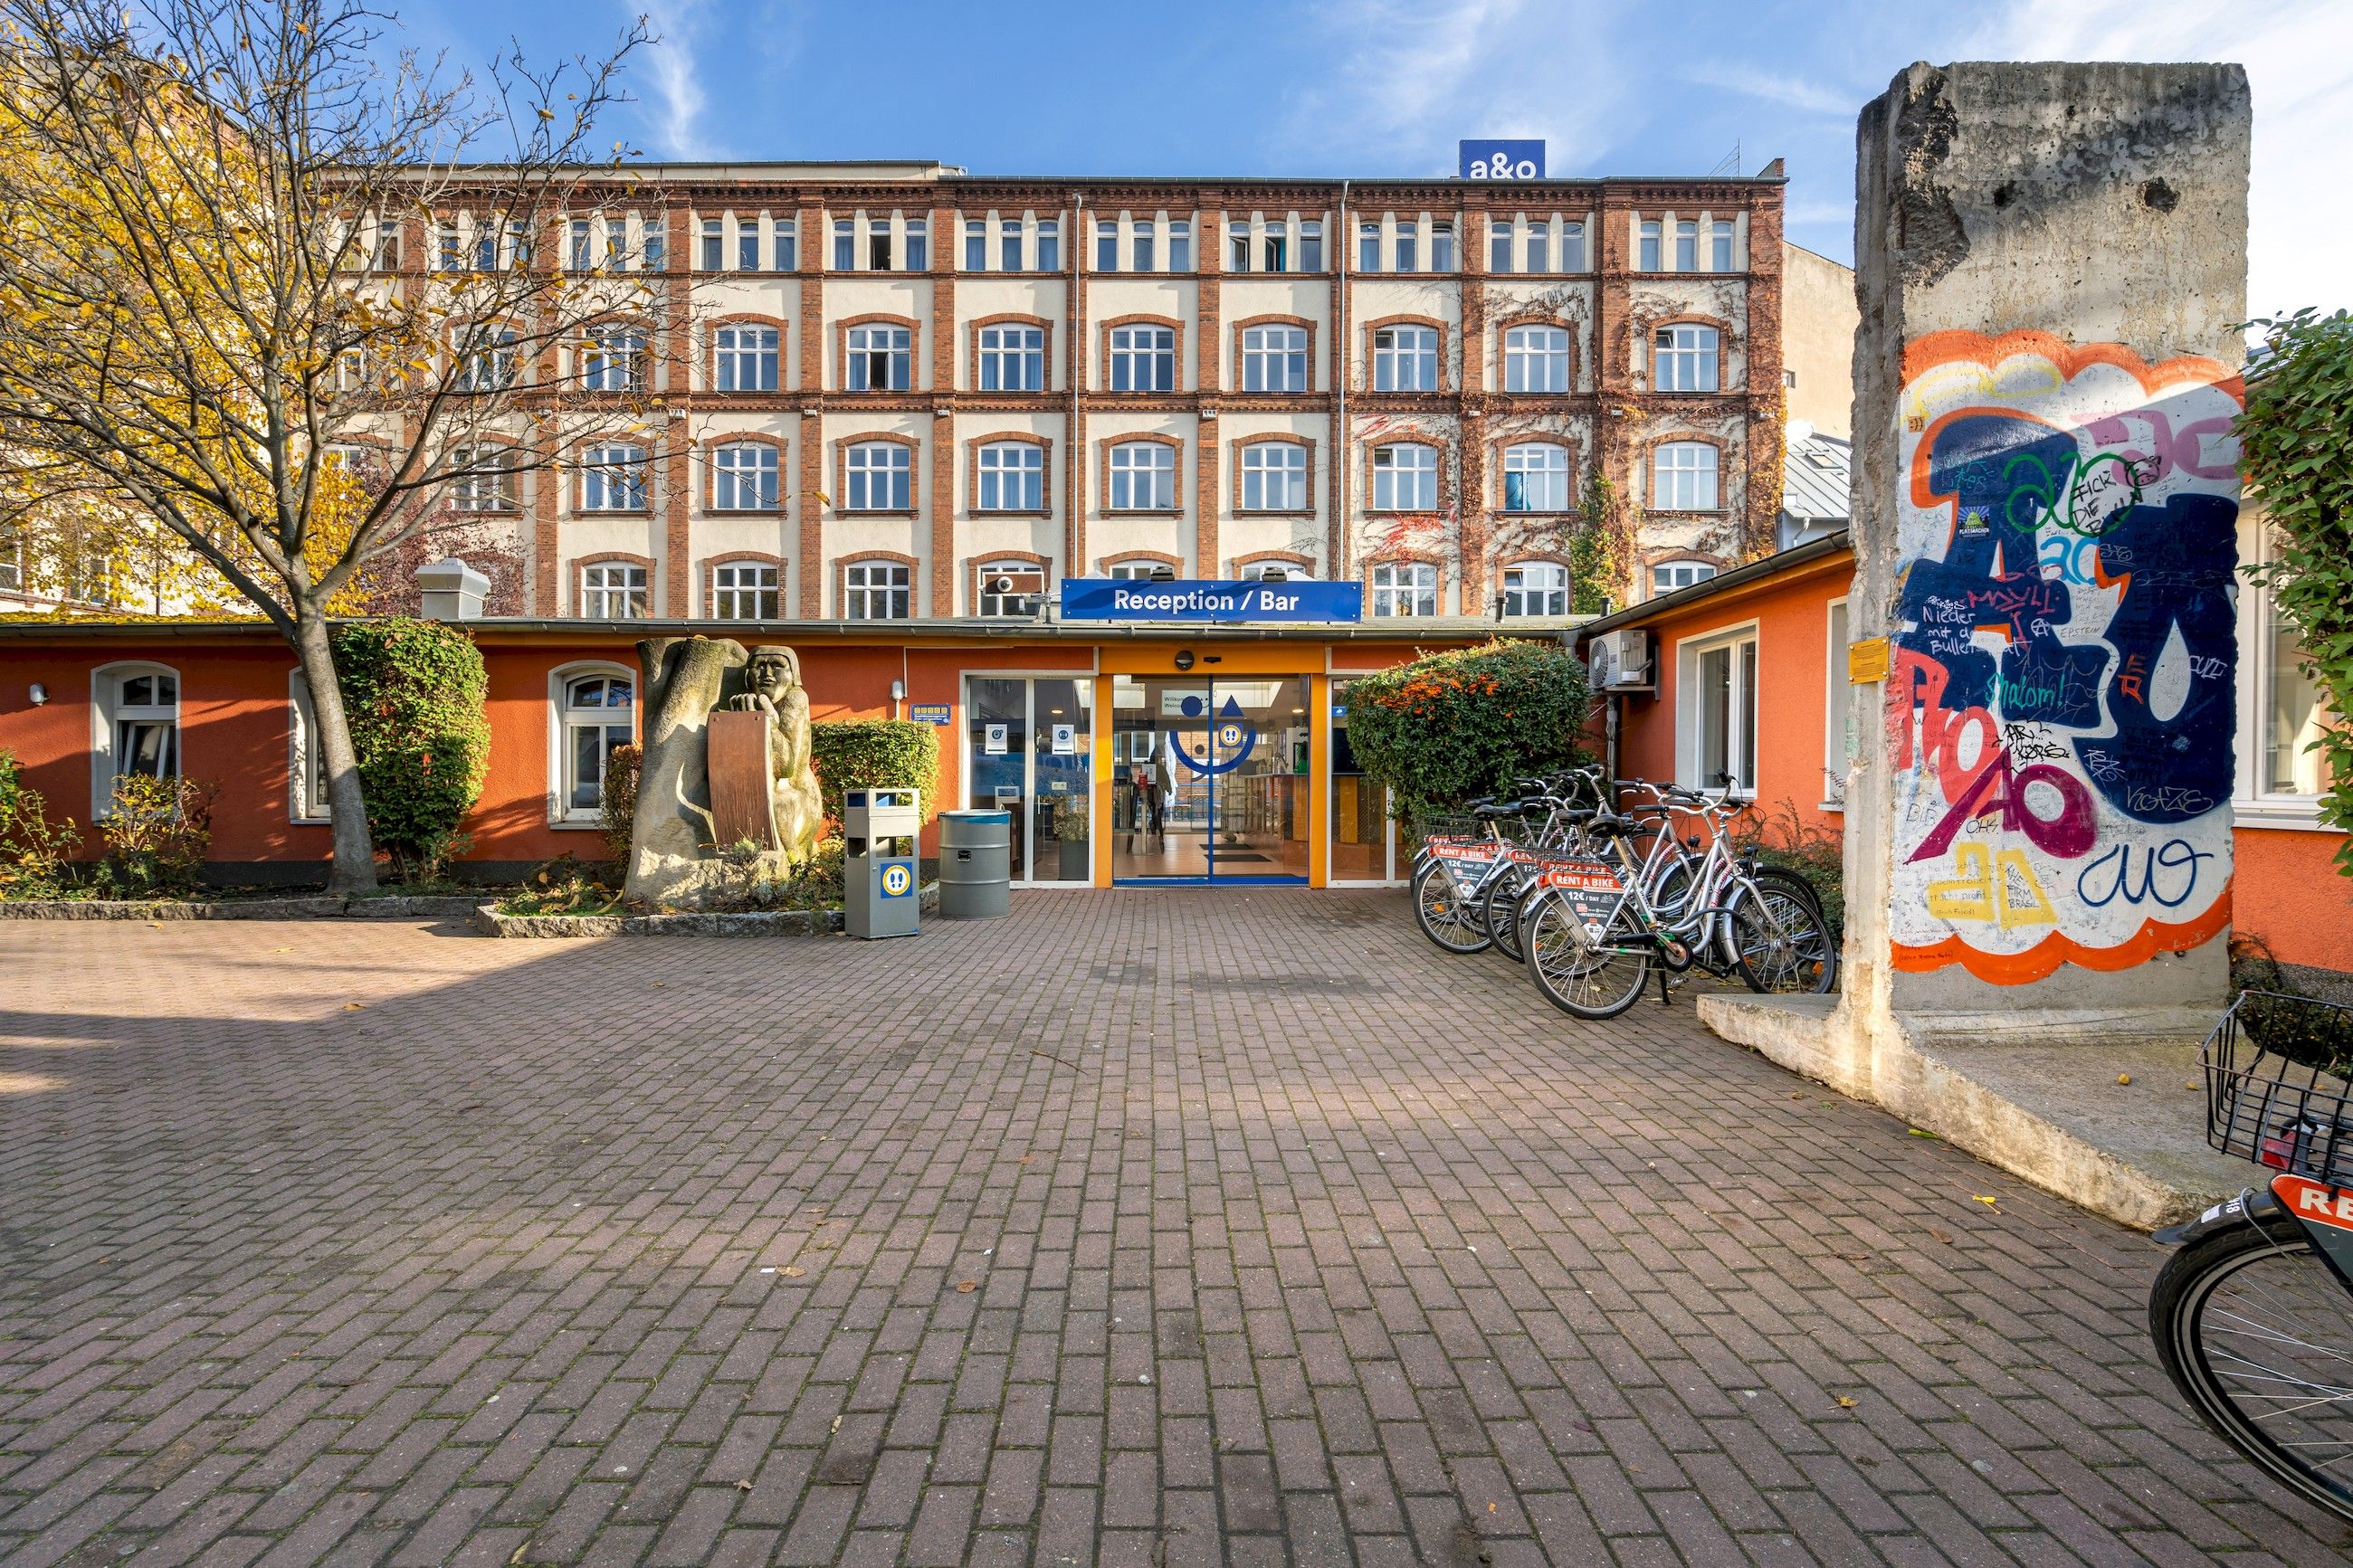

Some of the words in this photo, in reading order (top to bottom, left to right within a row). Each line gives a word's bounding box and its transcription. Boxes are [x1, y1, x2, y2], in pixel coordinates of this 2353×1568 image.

[1470, 152, 1537, 179] a&o
[1114, 589, 1234, 614] Reception
[1240, 590, 1254, 611] /
[1260, 591, 1300, 611] Bar
[1922, 605, 1977, 624] Nieder
[1928, 626, 1952, 639] mit
[1439, 847, 1461, 857] RENT
[1468, 851, 1485, 859] BIKE
[1556, 875, 1581, 886] RENT
[1583, 879, 1590, 887] A
[1591, 878, 1615, 888] BIKE
[1567, 891, 1585, 901] 12€
